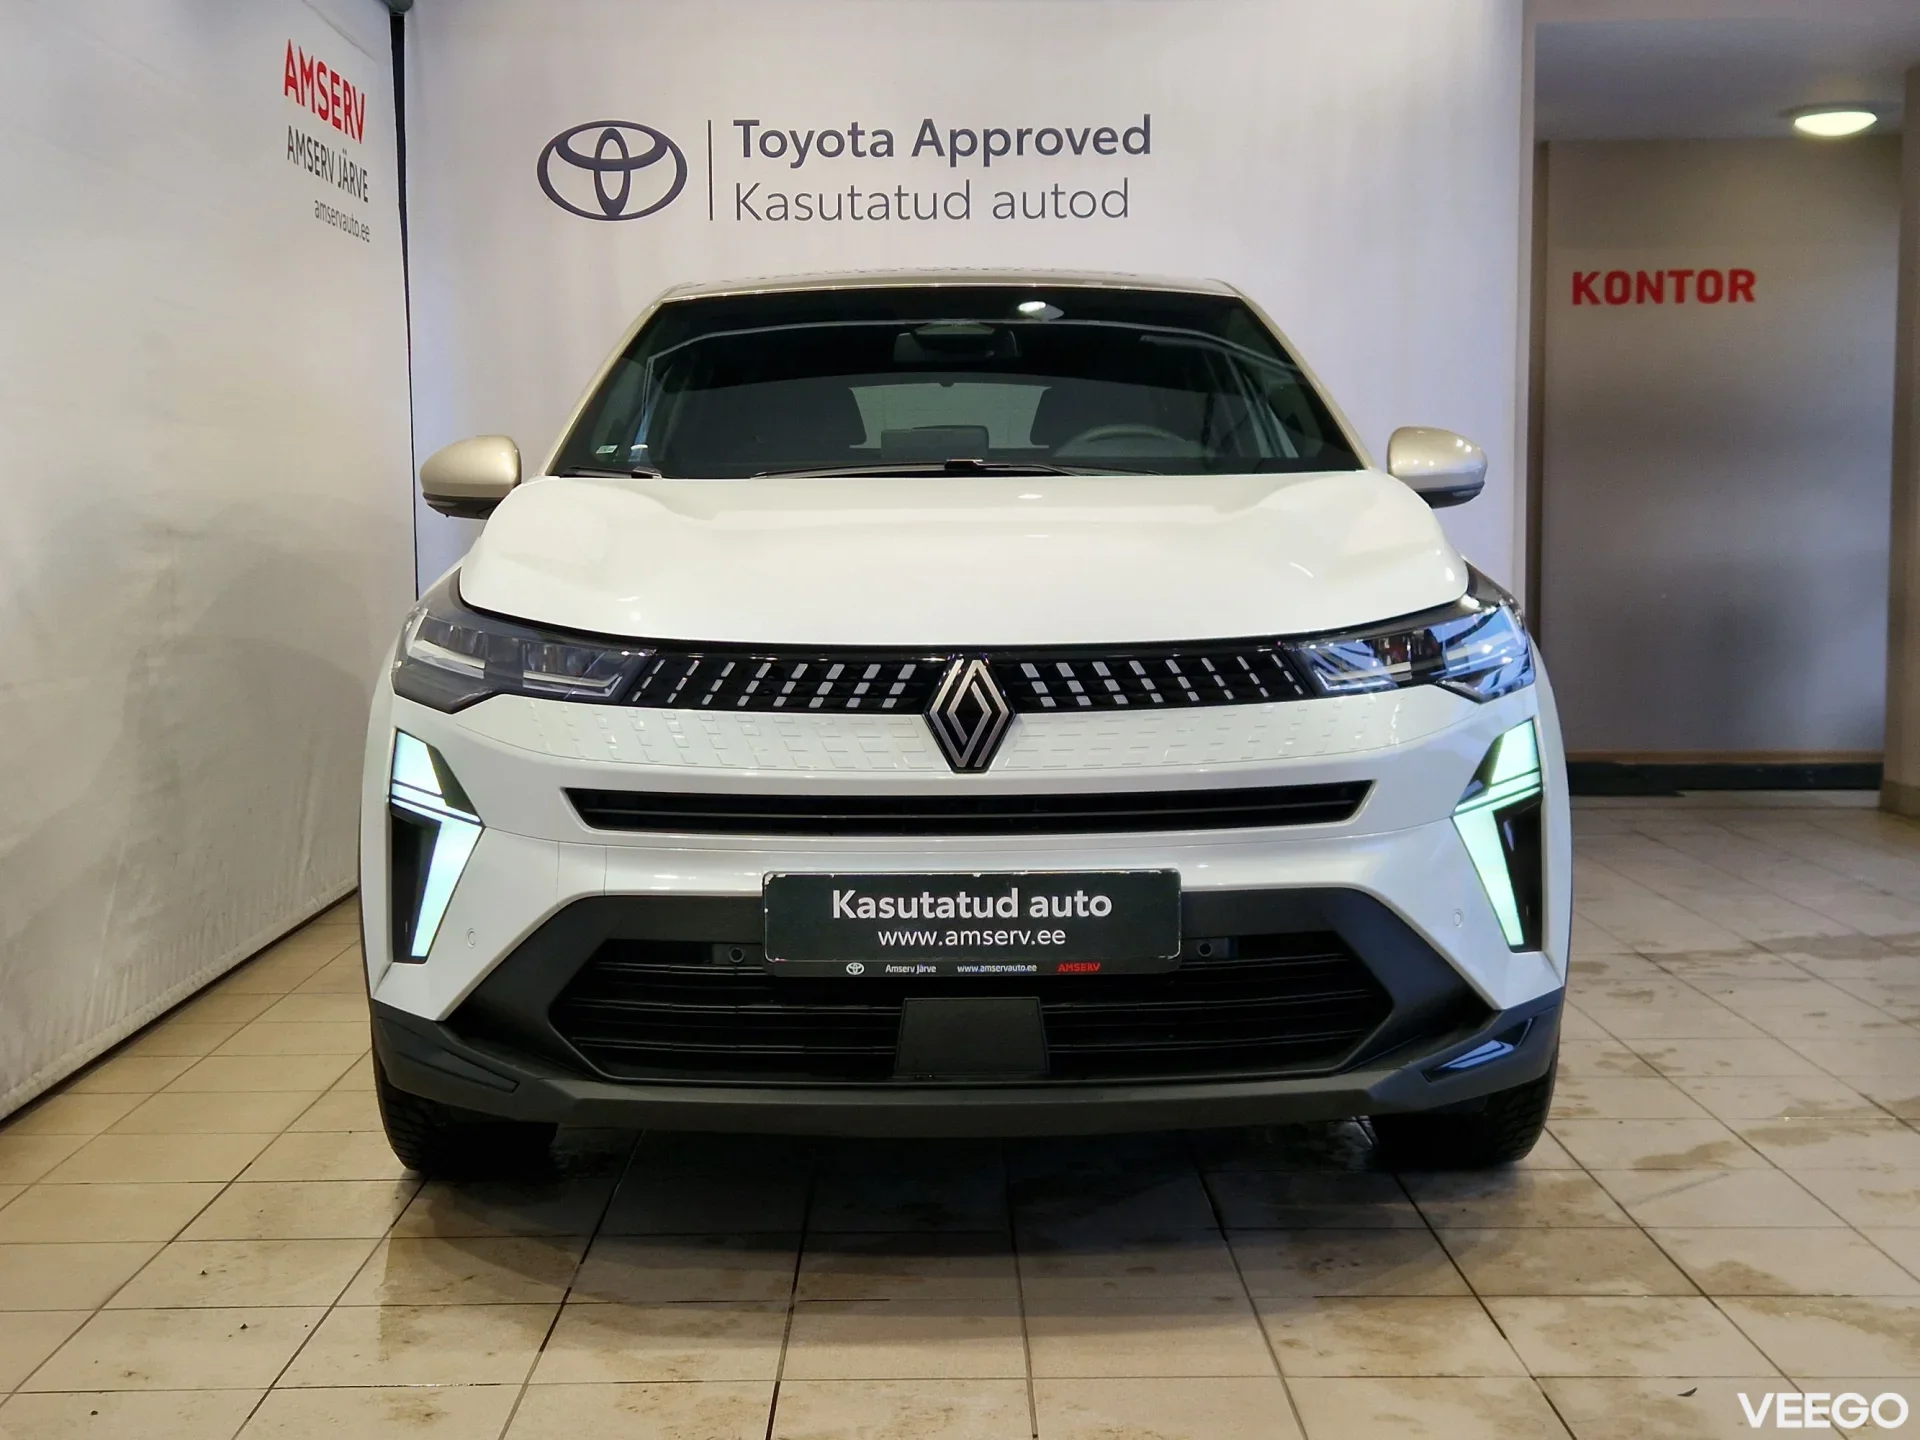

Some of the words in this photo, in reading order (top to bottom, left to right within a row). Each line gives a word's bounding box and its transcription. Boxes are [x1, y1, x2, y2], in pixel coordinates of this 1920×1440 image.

[284, 38, 365, 144] AMSERV
[733, 119, 895, 168] Toyota
[911, 114, 1152, 167] Approved
[287, 125, 335, 184] AMSERV
[338, 148, 369, 203] JÄRVE
[314, 199, 370, 243] amservauto.ee
[735, 179, 971, 221] Kasutatud
[992, 177, 1129, 220] autod
[1572, 268, 1756, 306] KONTOR
[832, 888, 1019, 919] Kasutatud
[1029, 890, 1112, 918] auto
[878, 928, 1066, 947] www.amserv.ee
[885, 964, 915, 974] Amserv
[957, 963, 1038, 973] www.amservauto.ee
[1058, 963, 1100, 972] AMSERV
